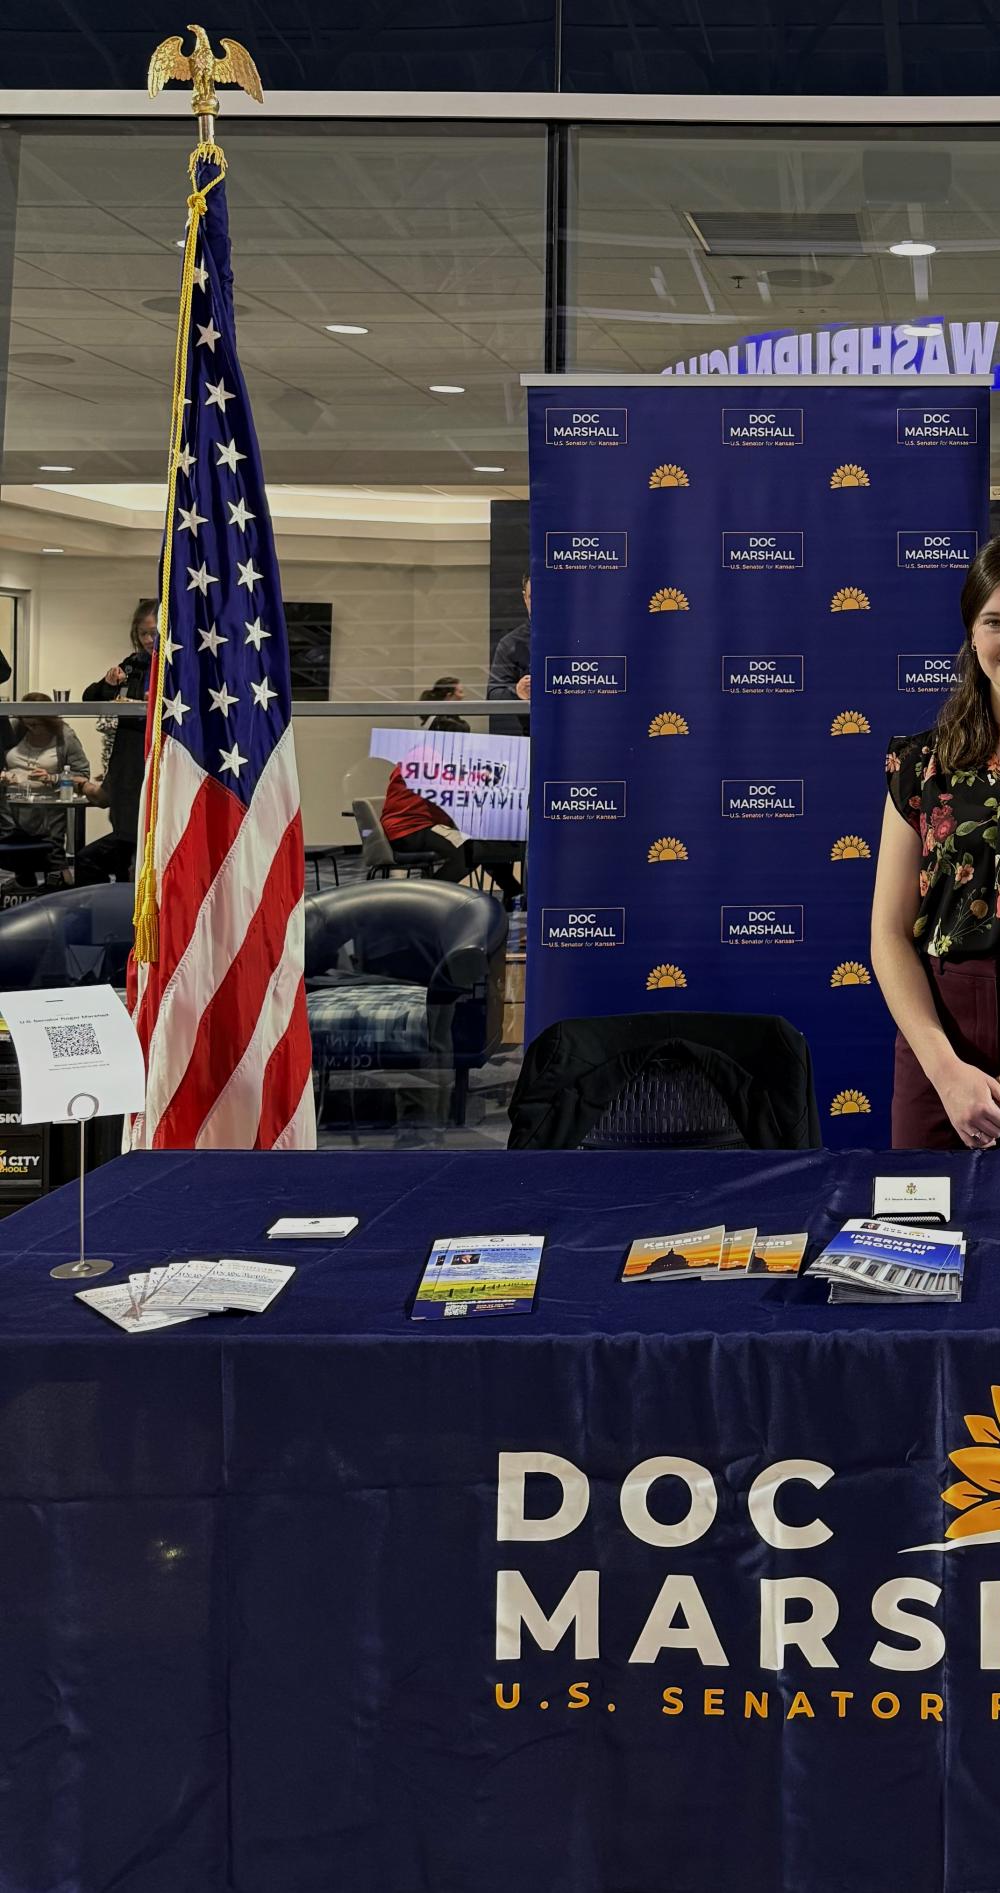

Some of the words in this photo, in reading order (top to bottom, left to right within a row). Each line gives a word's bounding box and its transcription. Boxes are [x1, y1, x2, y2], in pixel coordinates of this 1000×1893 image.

[573, 414, 600, 423] DOC
[750, 415, 776, 423] DOC
[924, 414, 950, 423] DOC
[554, 427, 619, 436] MARSHALL
[731, 428, 795, 436] MARSHALL
[905, 427, 969, 436] MARSHALL
[573, 538, 600, 547] DOC
[750, 538, 776, 547] DOC
[925, 537, 951, 546] DOC
[554, 551, 619, 560] MARSHALL
[731, 551, 796, 560] MARSHALL
[906, 550, 970, 559] MARSHALL
[572, 662, 599, 671] DOC
[750, 662, 776, 670] DOC
[925, 661, 951, 669] DOC
[553, 675, 618, 684] MARSHALL
[731, 675, 796, 683] MARSHALL
[571, 788, 598, 797] DOC
[750, 786, 776, 795] DOC
[552, 801, 618, 810] MARSHALL
[730, 799, 796, 808] MARSHALL
[569, 914, 597, 924] DOC
[749, 912, 776, 921] DOC
[550, 928, 616, 937] MARSHALL
[730, 925, 795, 934] MARSHALL
[8, 1155, 40, 1166] CITY
[850, 1233, 937, 1251] INTERNSHIP
[853, 1239, 926, 1256] PROGRAM
[496, 1451, 835, 1551] DOC
[495, 1682, 616, 1712] U.S.
[662, 1686, 944, 1723] SENATOR
